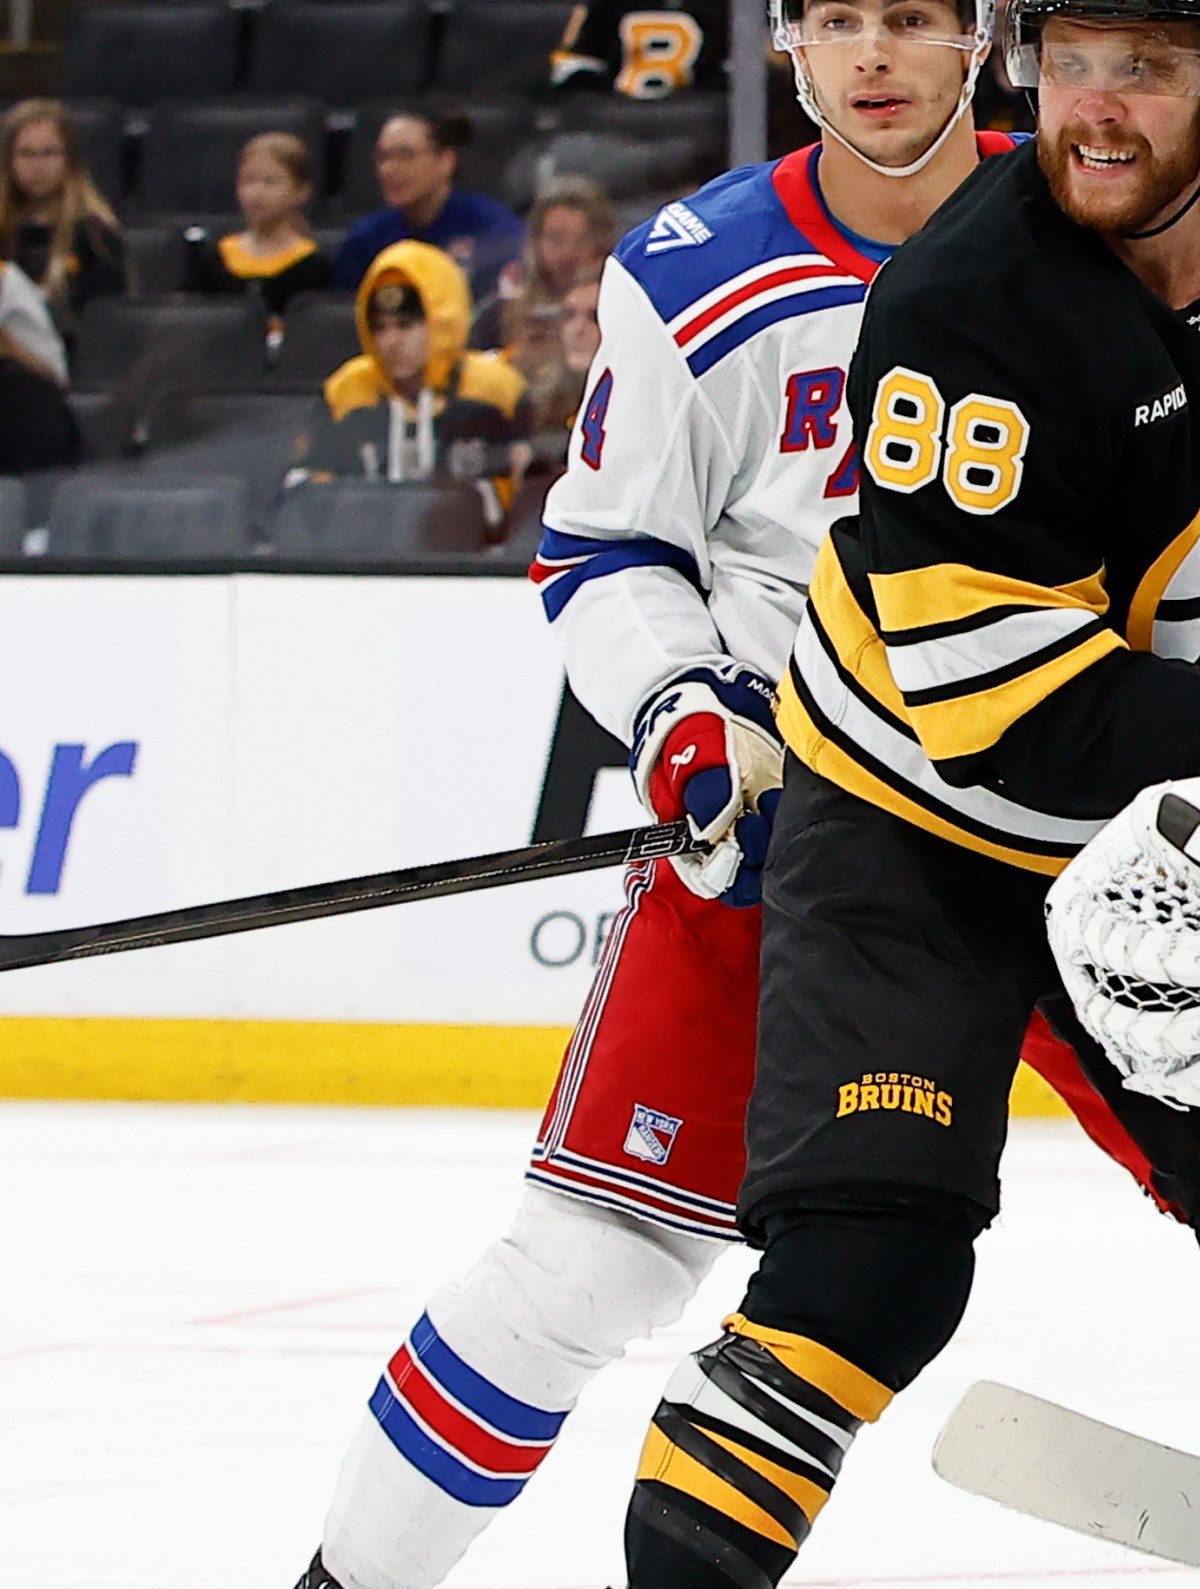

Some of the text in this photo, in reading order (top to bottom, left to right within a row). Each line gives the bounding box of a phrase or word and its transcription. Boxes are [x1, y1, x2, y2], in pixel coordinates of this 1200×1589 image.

[667, 203, 714, 244] GAME
[1134, 383, 1188, 427] RAPID
[864, 365, 1029, 515] 88
[0, 740, 139, 896] r
[836, 1082, 953, 1127] BRUINS
[861, 1073, 935, 1092] BOSTON
